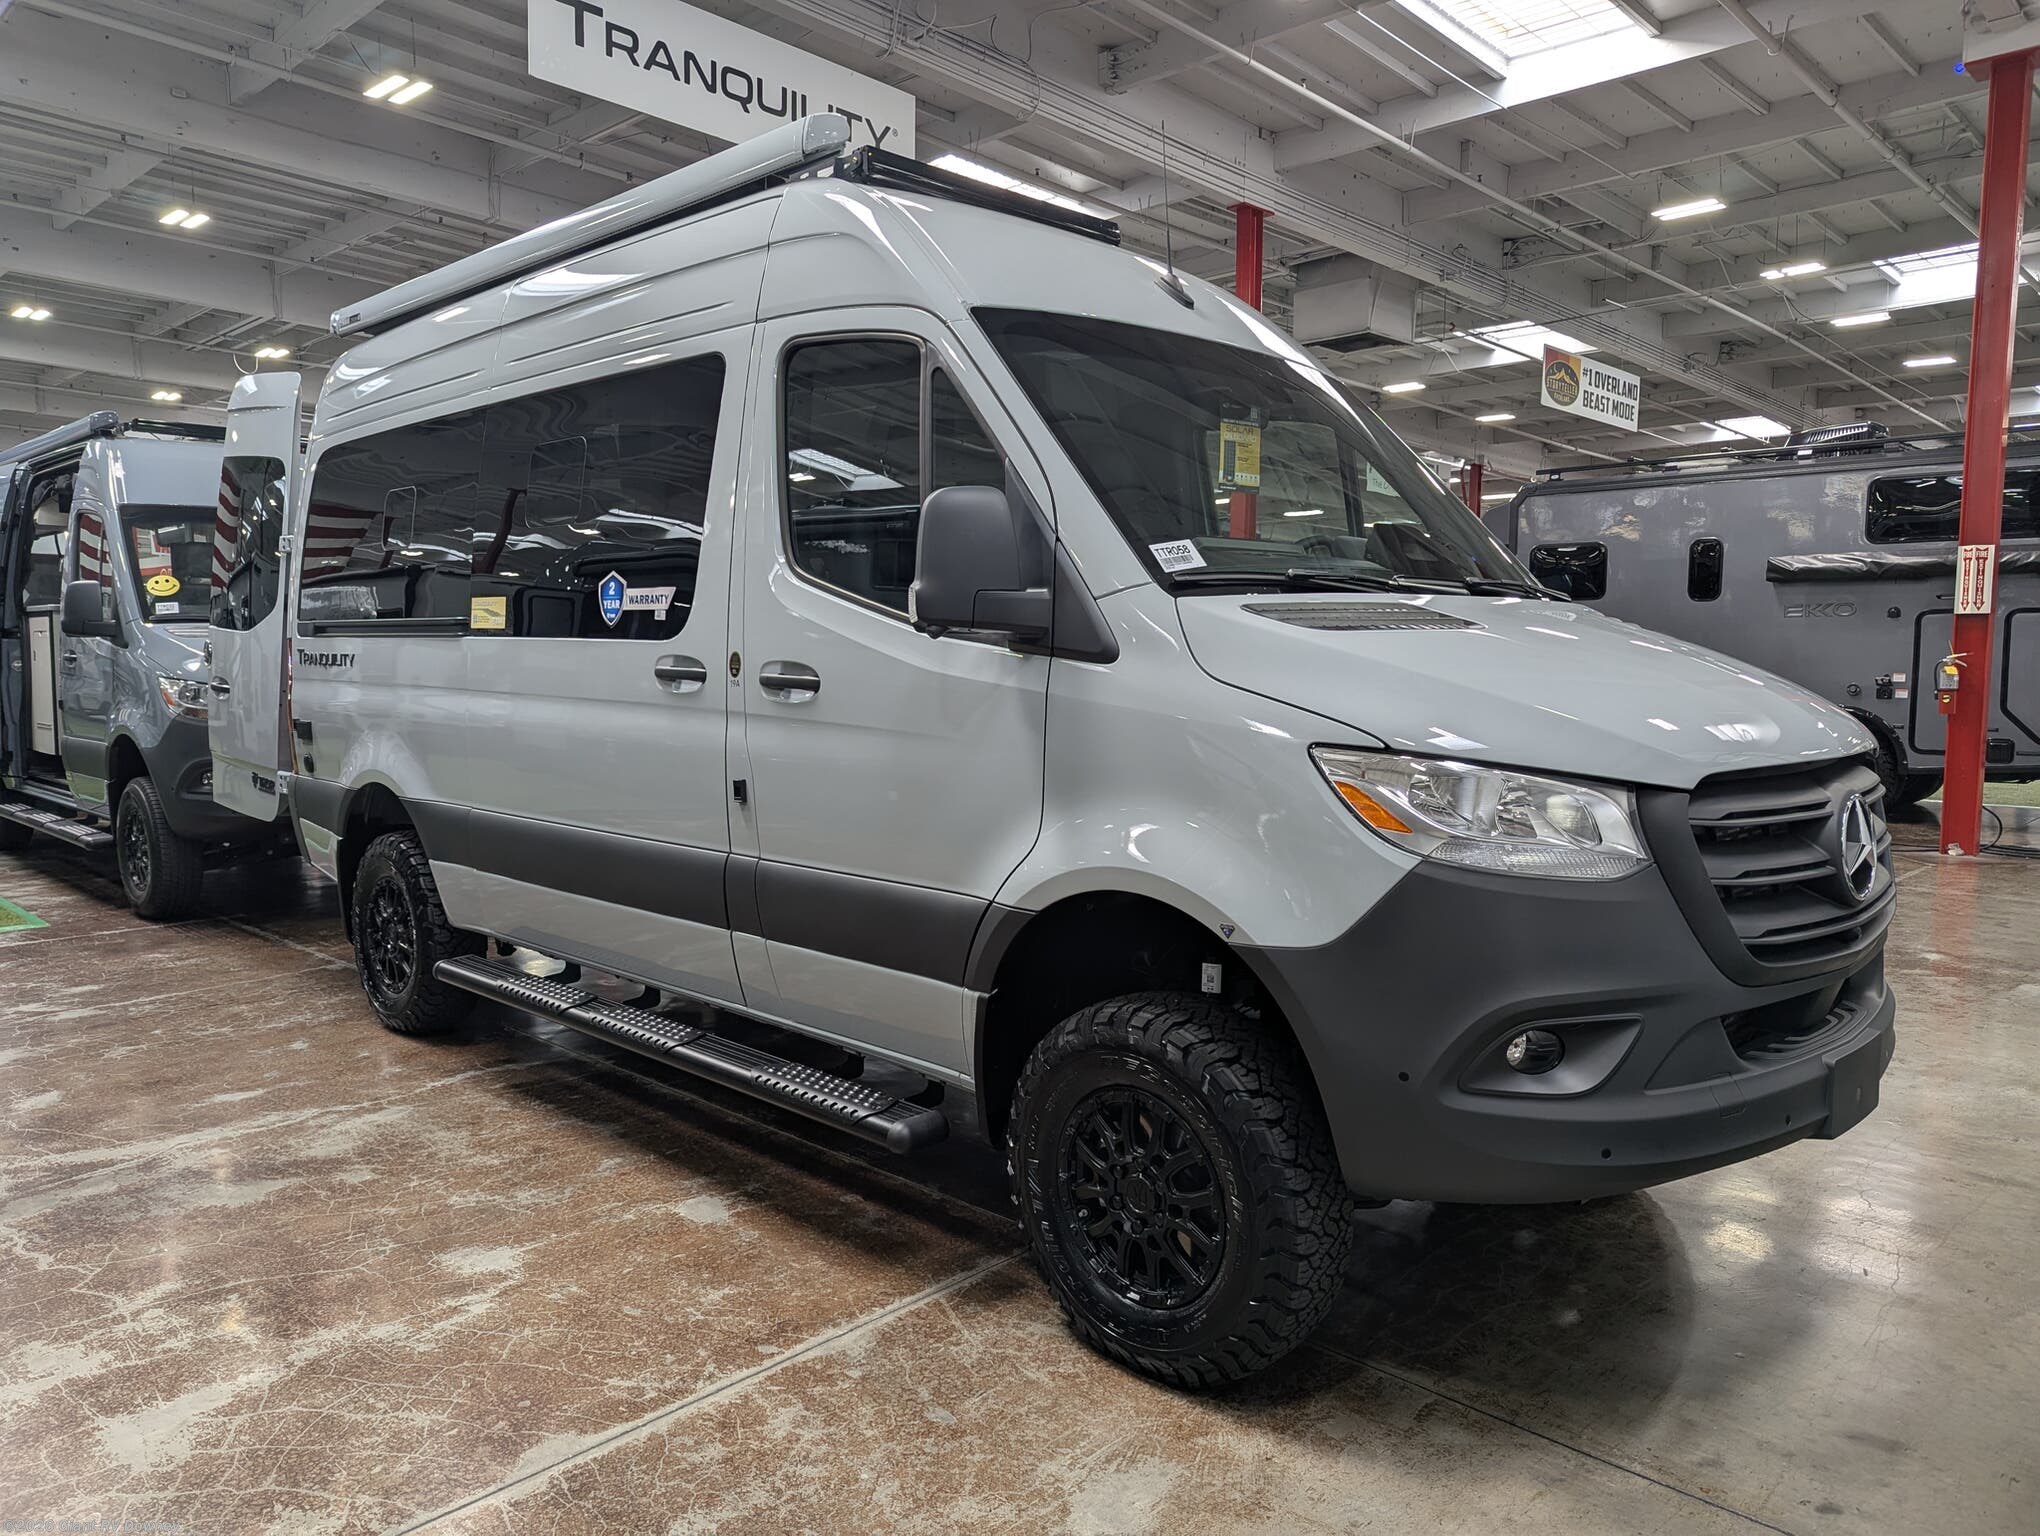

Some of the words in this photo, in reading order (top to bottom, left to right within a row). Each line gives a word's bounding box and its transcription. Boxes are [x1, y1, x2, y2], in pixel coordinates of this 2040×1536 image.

[1594, 370, 1639, 401] OVERLAND
[1582, 389, 1611, 414] BEAST
[1611, 399, 1635, 422] MODE
[608, 581, 616, 595] 2
[603, 599, 620, 609] YEAR
[628, 593, 669, 605] WARRANTY
